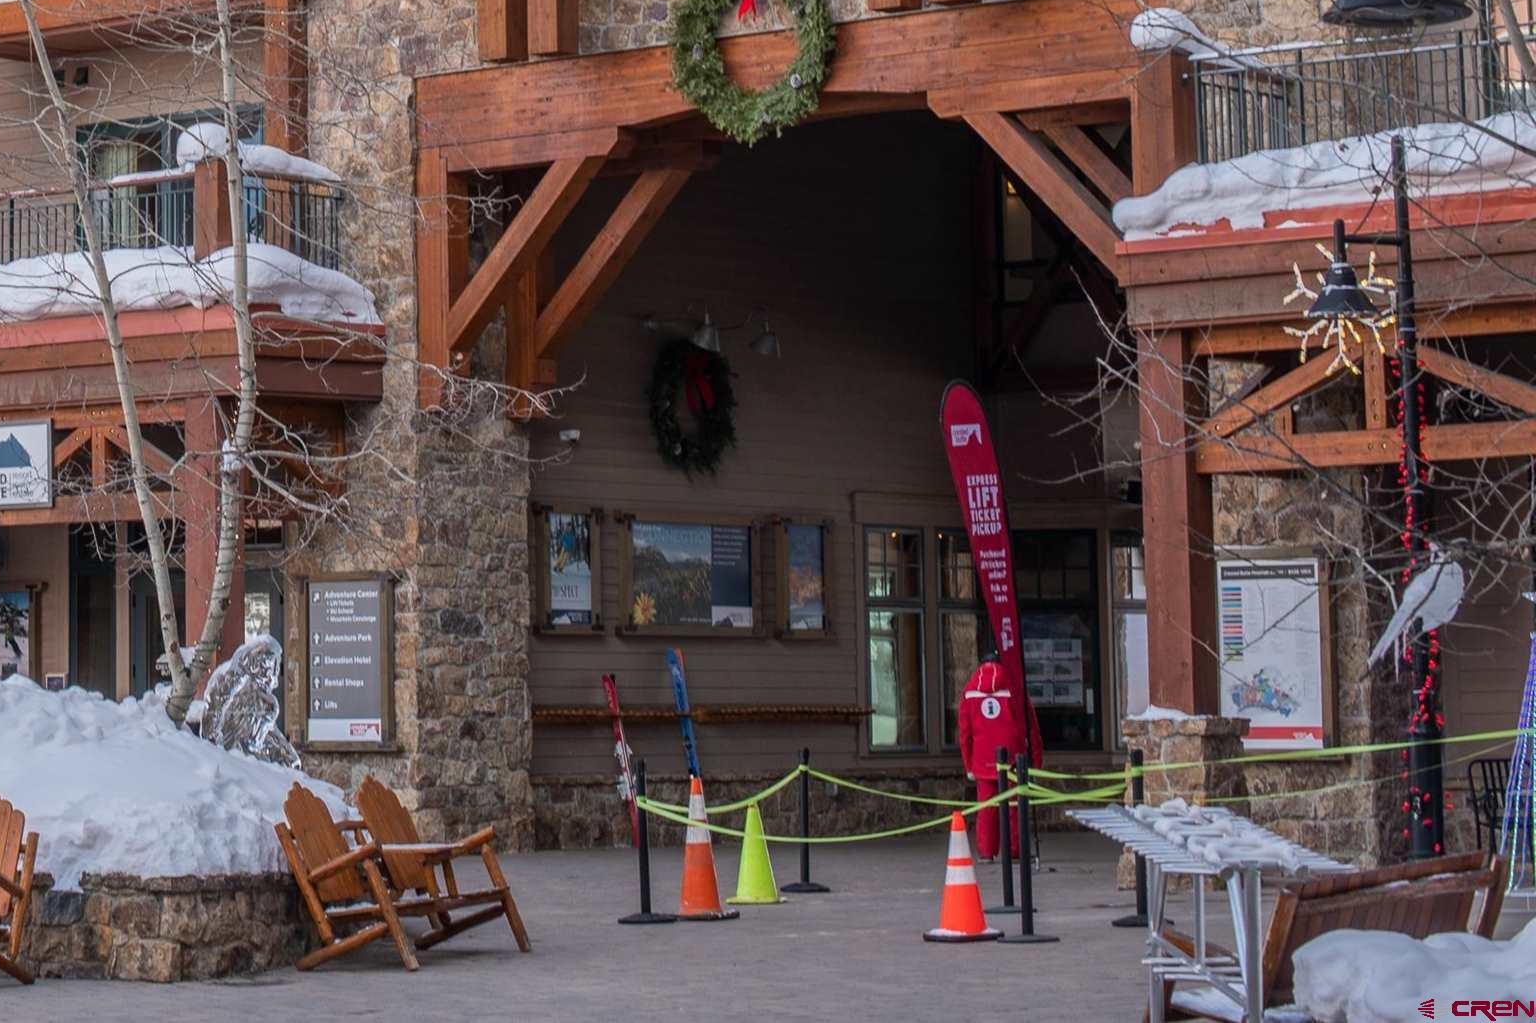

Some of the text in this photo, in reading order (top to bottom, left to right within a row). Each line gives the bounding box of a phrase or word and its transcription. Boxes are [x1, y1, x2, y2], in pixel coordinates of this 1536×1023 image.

[966, 474, 998, 486] EXPRESS
[967, 486, 999, 509] LIFT
[970, 508, 1001, 523] TICKET
[971, 521, 1002, 537] PICKUP
[325, 590, 378, 599] Adventure Center
[325, 634, 372, 643] Adventure Park
[324, 656, 371, 665] Elevation Hotel
[324, 678, 364, 688] Rental Shops
[324, 700, 338, 709] Lifts
